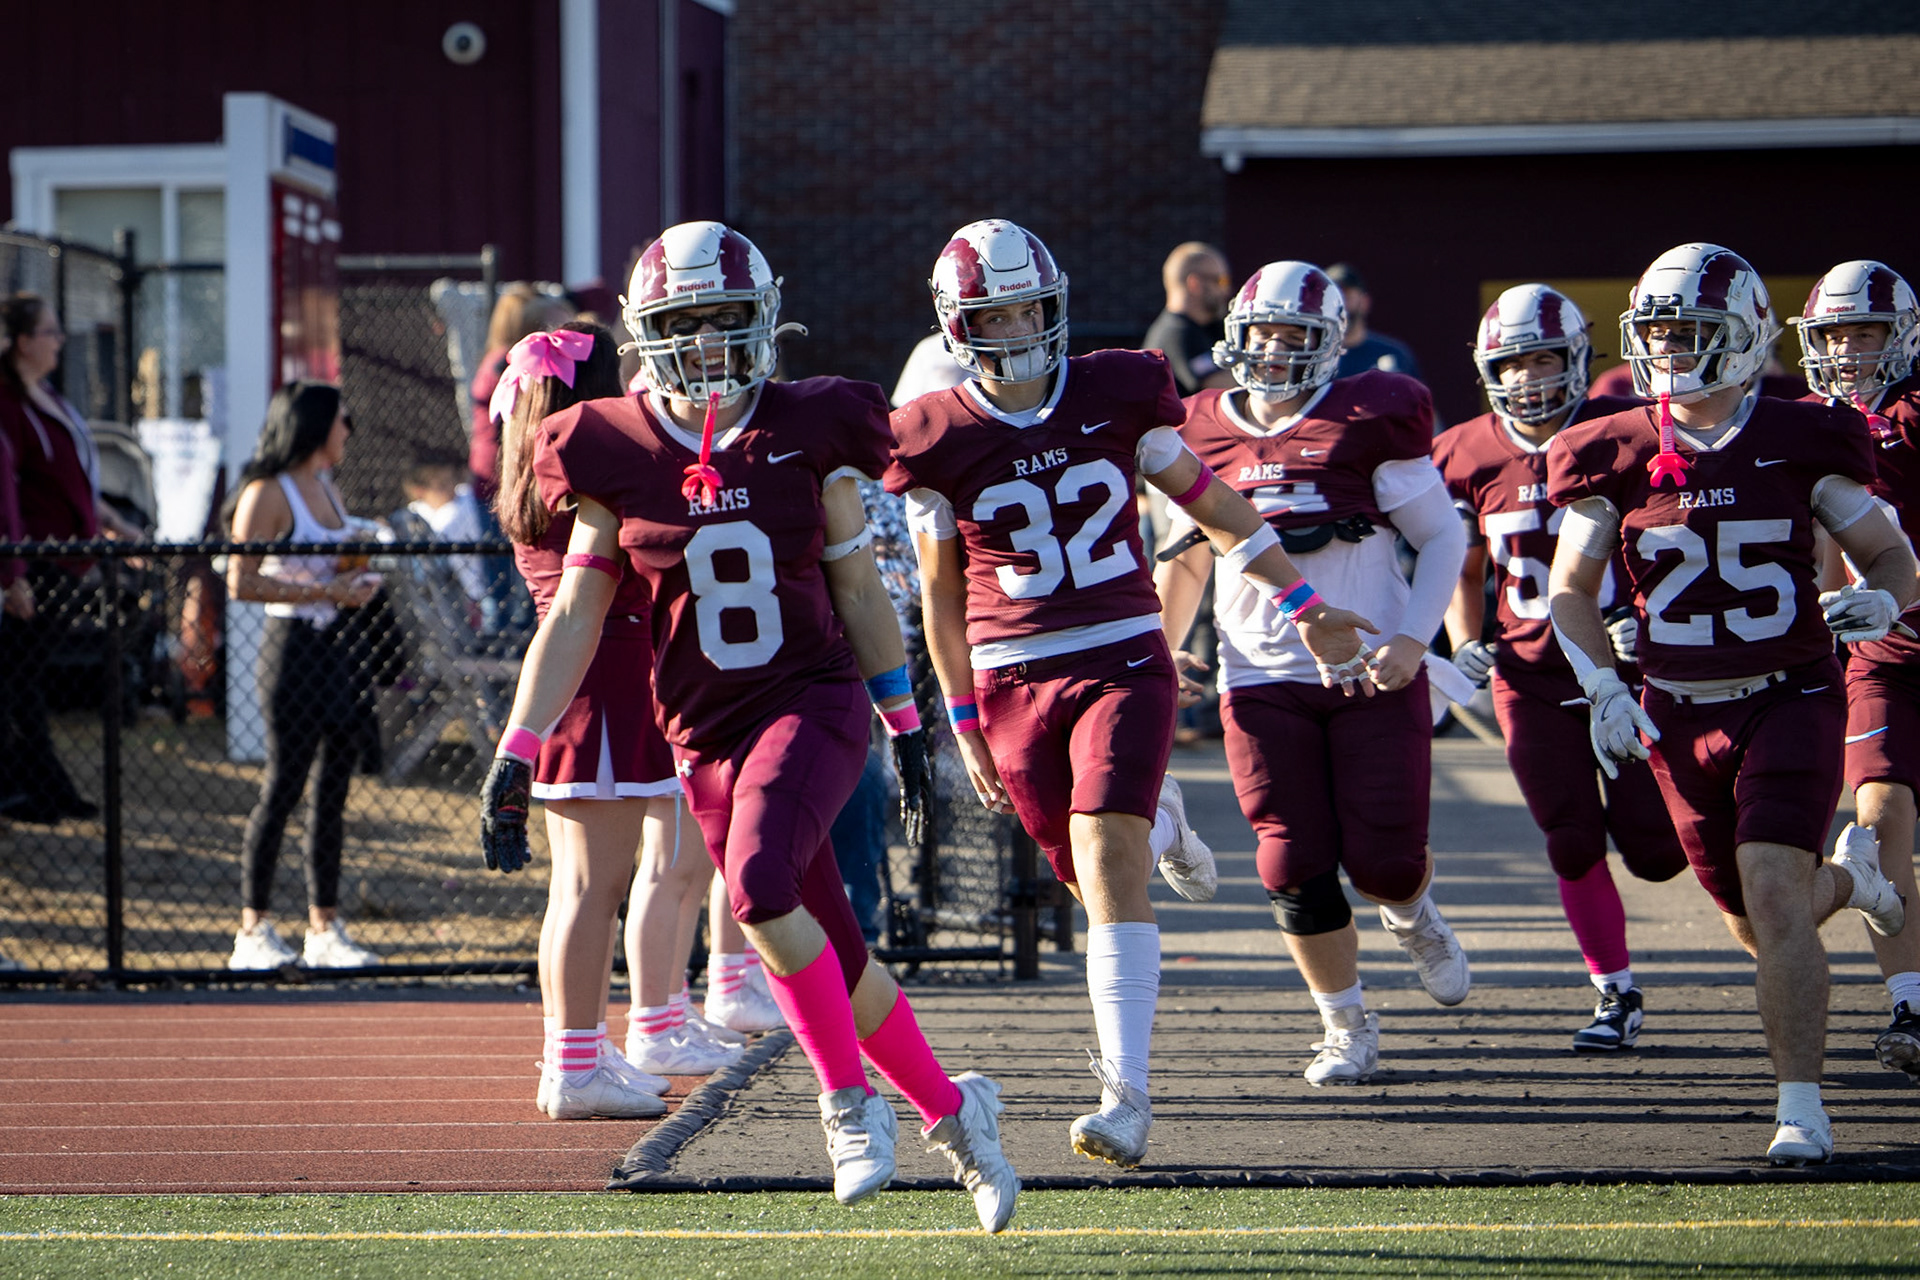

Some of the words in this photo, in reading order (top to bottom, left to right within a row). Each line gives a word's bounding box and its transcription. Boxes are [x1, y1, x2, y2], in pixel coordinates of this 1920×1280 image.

[999, 280, 1032, 292] Riddell
[1012, 447, 1068, 477] RAMS
[1238, 463, 1284, 482] RAMS
[1517, 482, 1548, 502] RA
[1677, 488, 1736, 509] RAMS
[972, 457, 1140, 600] 32
[1485, 505, 1616, 620] 5
[684, 519, 784, 671] 8
[1636, 518, 1797, 646] 25
